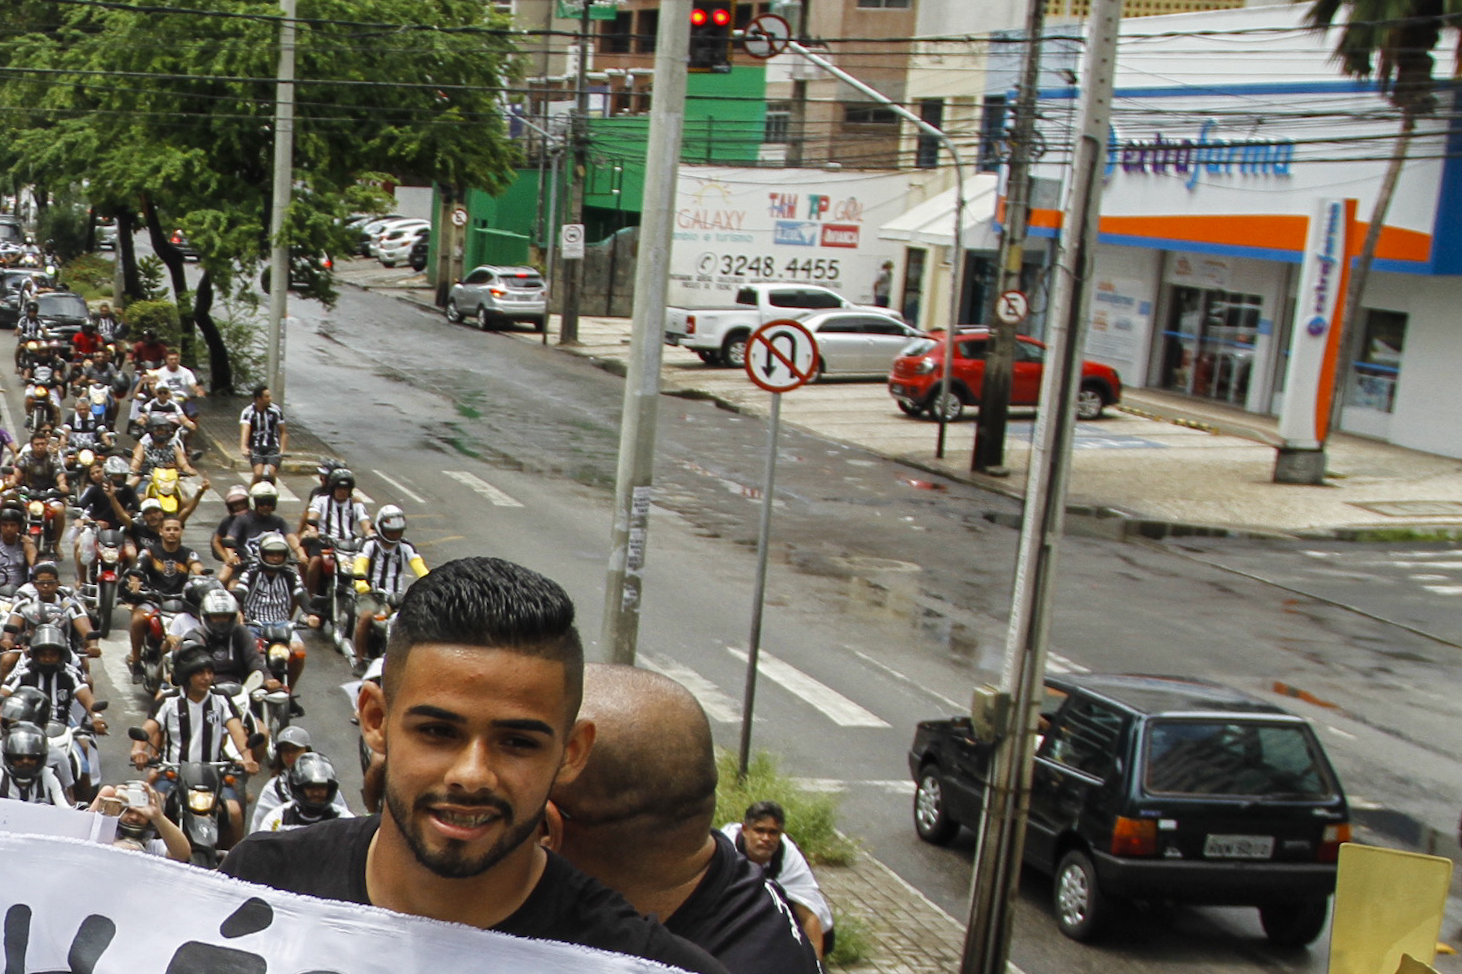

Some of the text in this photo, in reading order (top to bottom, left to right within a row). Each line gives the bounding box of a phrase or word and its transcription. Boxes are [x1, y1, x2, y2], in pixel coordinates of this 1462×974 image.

[1123, 118, 1294, 189] extrafarma
[677, 208, 747, 231] GALAXY
[720, 254, 840, 281] 3248.4455
